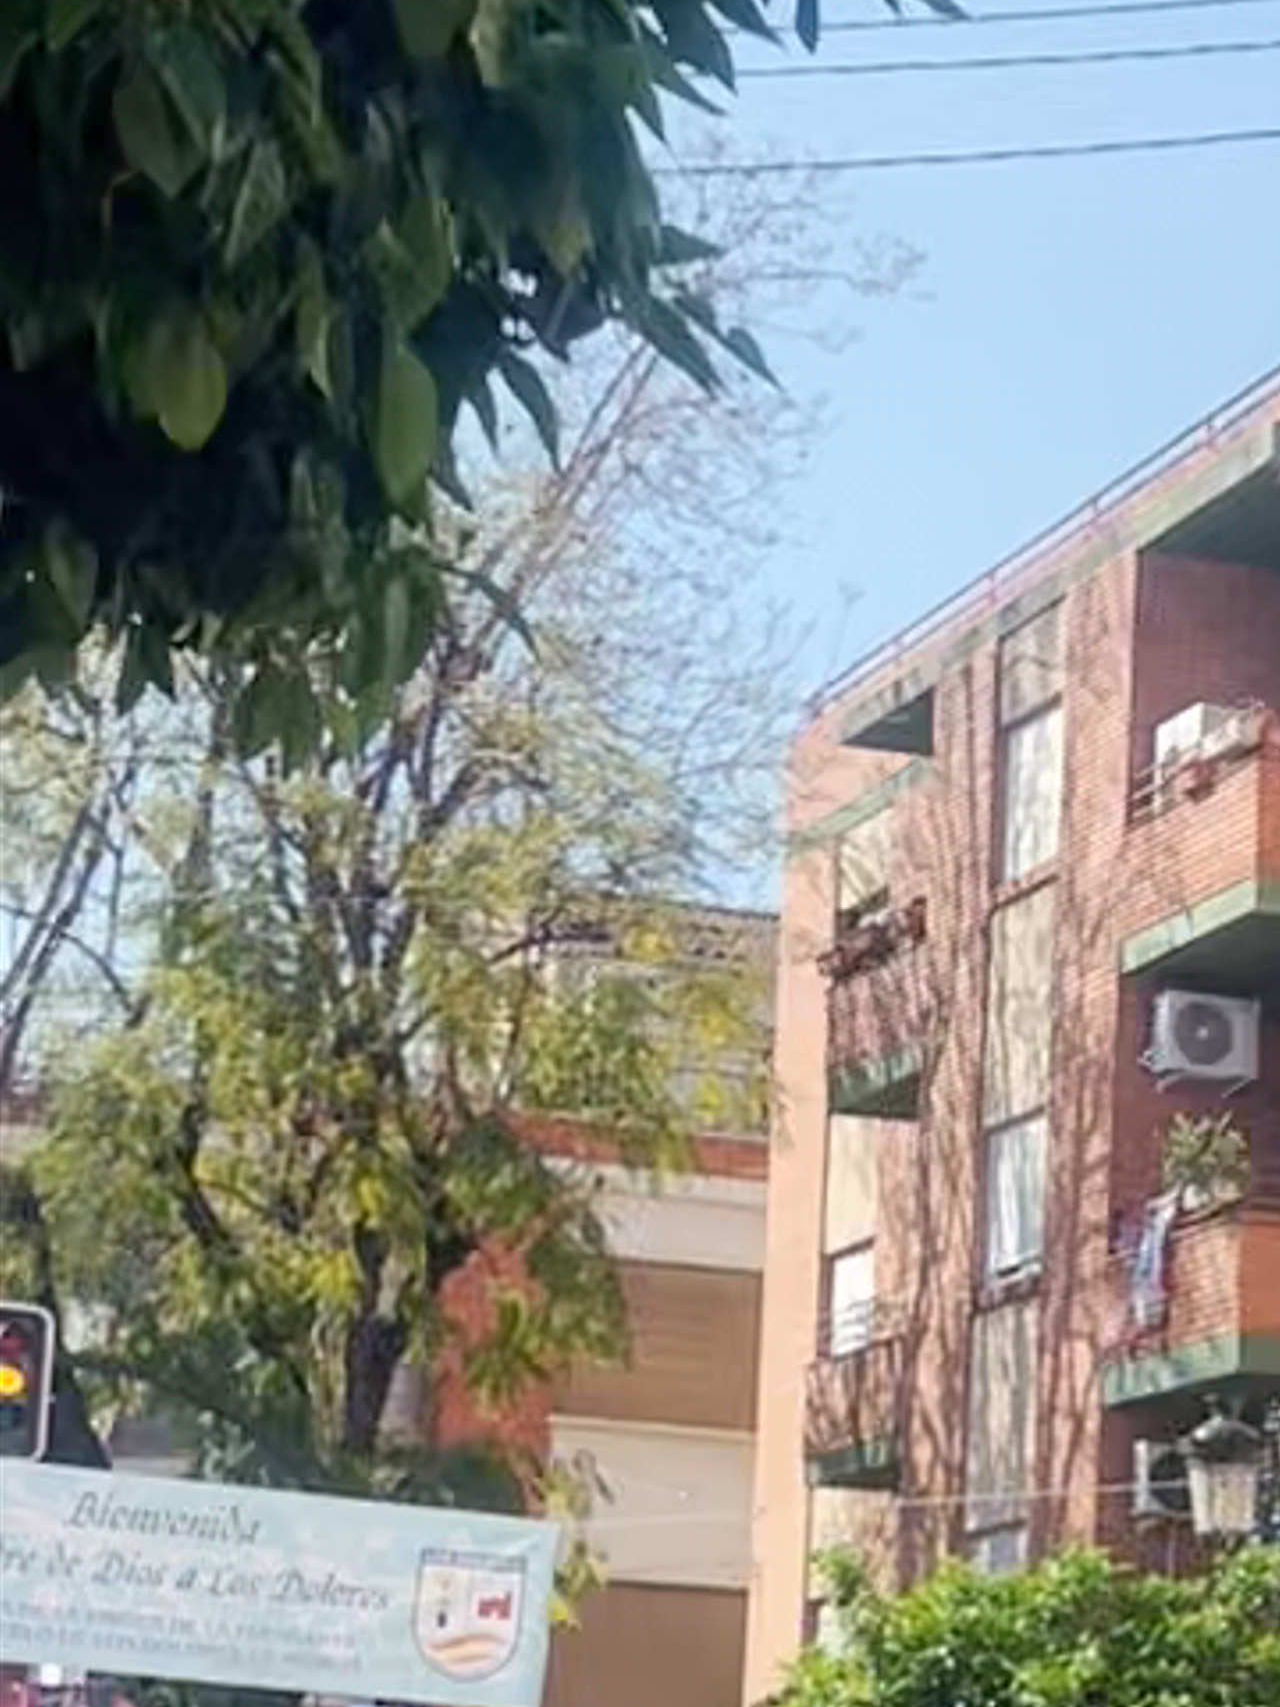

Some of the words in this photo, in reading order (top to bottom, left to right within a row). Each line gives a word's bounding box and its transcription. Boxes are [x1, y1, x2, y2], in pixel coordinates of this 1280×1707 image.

[62, 1491, 262, 1543] Bienvenida
[46, 1543, 83, 1578] de
[91, 1549, 169, 1588] Dios
[174, 1566, 199, 1590] a
[207, 1563, 264, 1596] Los
[269, 1567, 390, 1611] Dolores
